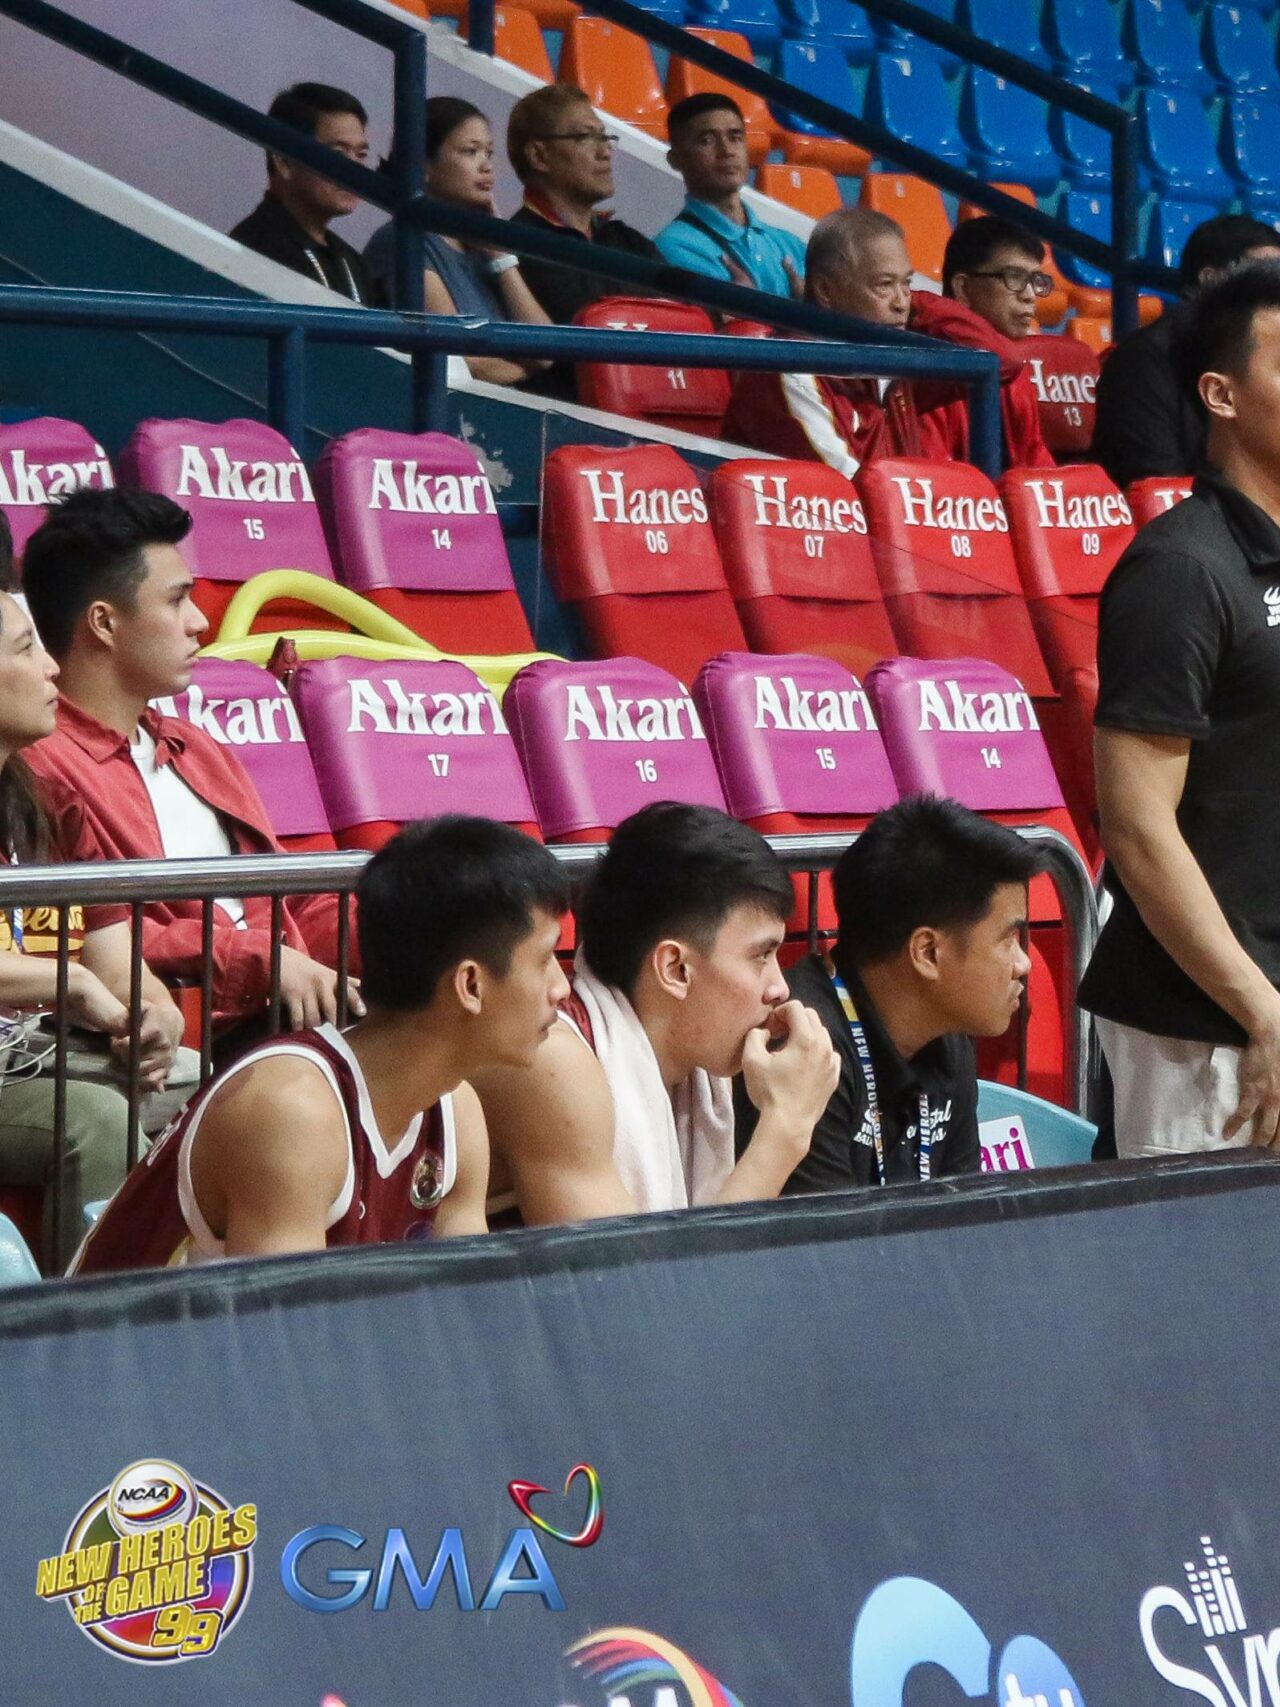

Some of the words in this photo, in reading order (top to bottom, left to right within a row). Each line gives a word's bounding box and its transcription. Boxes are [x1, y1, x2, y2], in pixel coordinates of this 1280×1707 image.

[667, 369, 687, 390] 11
[1024, 359, 1100, 404] ane
[1064, 406, 1082, 427] 13
[176, 446, 316, 503] Akari
[368, 458, 499, 516] Akari
[580, 470, 709, 525] Hanes
[744, 475, 868, 535] Hanes
[890, 476, 1009, 533] Hanes
[1024, 480, 1132, 529] Hanes
[243, 518, 265, 540] 15
[431, 528, 452, 551] 14
[645, 530, 668, 554] 06
[804, 535, 825, 558] 07
[951, 535, 972, 558] 08
[1082, 533, 1100, 556] 09
[148, 679, 306, 745] kari
[346, 679, 511, 736] Akari
[563, 682, 706, 742] Akari
[753, 676, 879, 732] Akari
[917, 679, 1041, 734] Akari
[427, 753, 450, 778] 17
[636, 760, 657, 783] 16
[815, 748, 836, 770] 15
[981, 748, 1002, 769] 14
[851, 1027, 871, 1058] NEW
[979, 1127, 1031, 1174] ari
